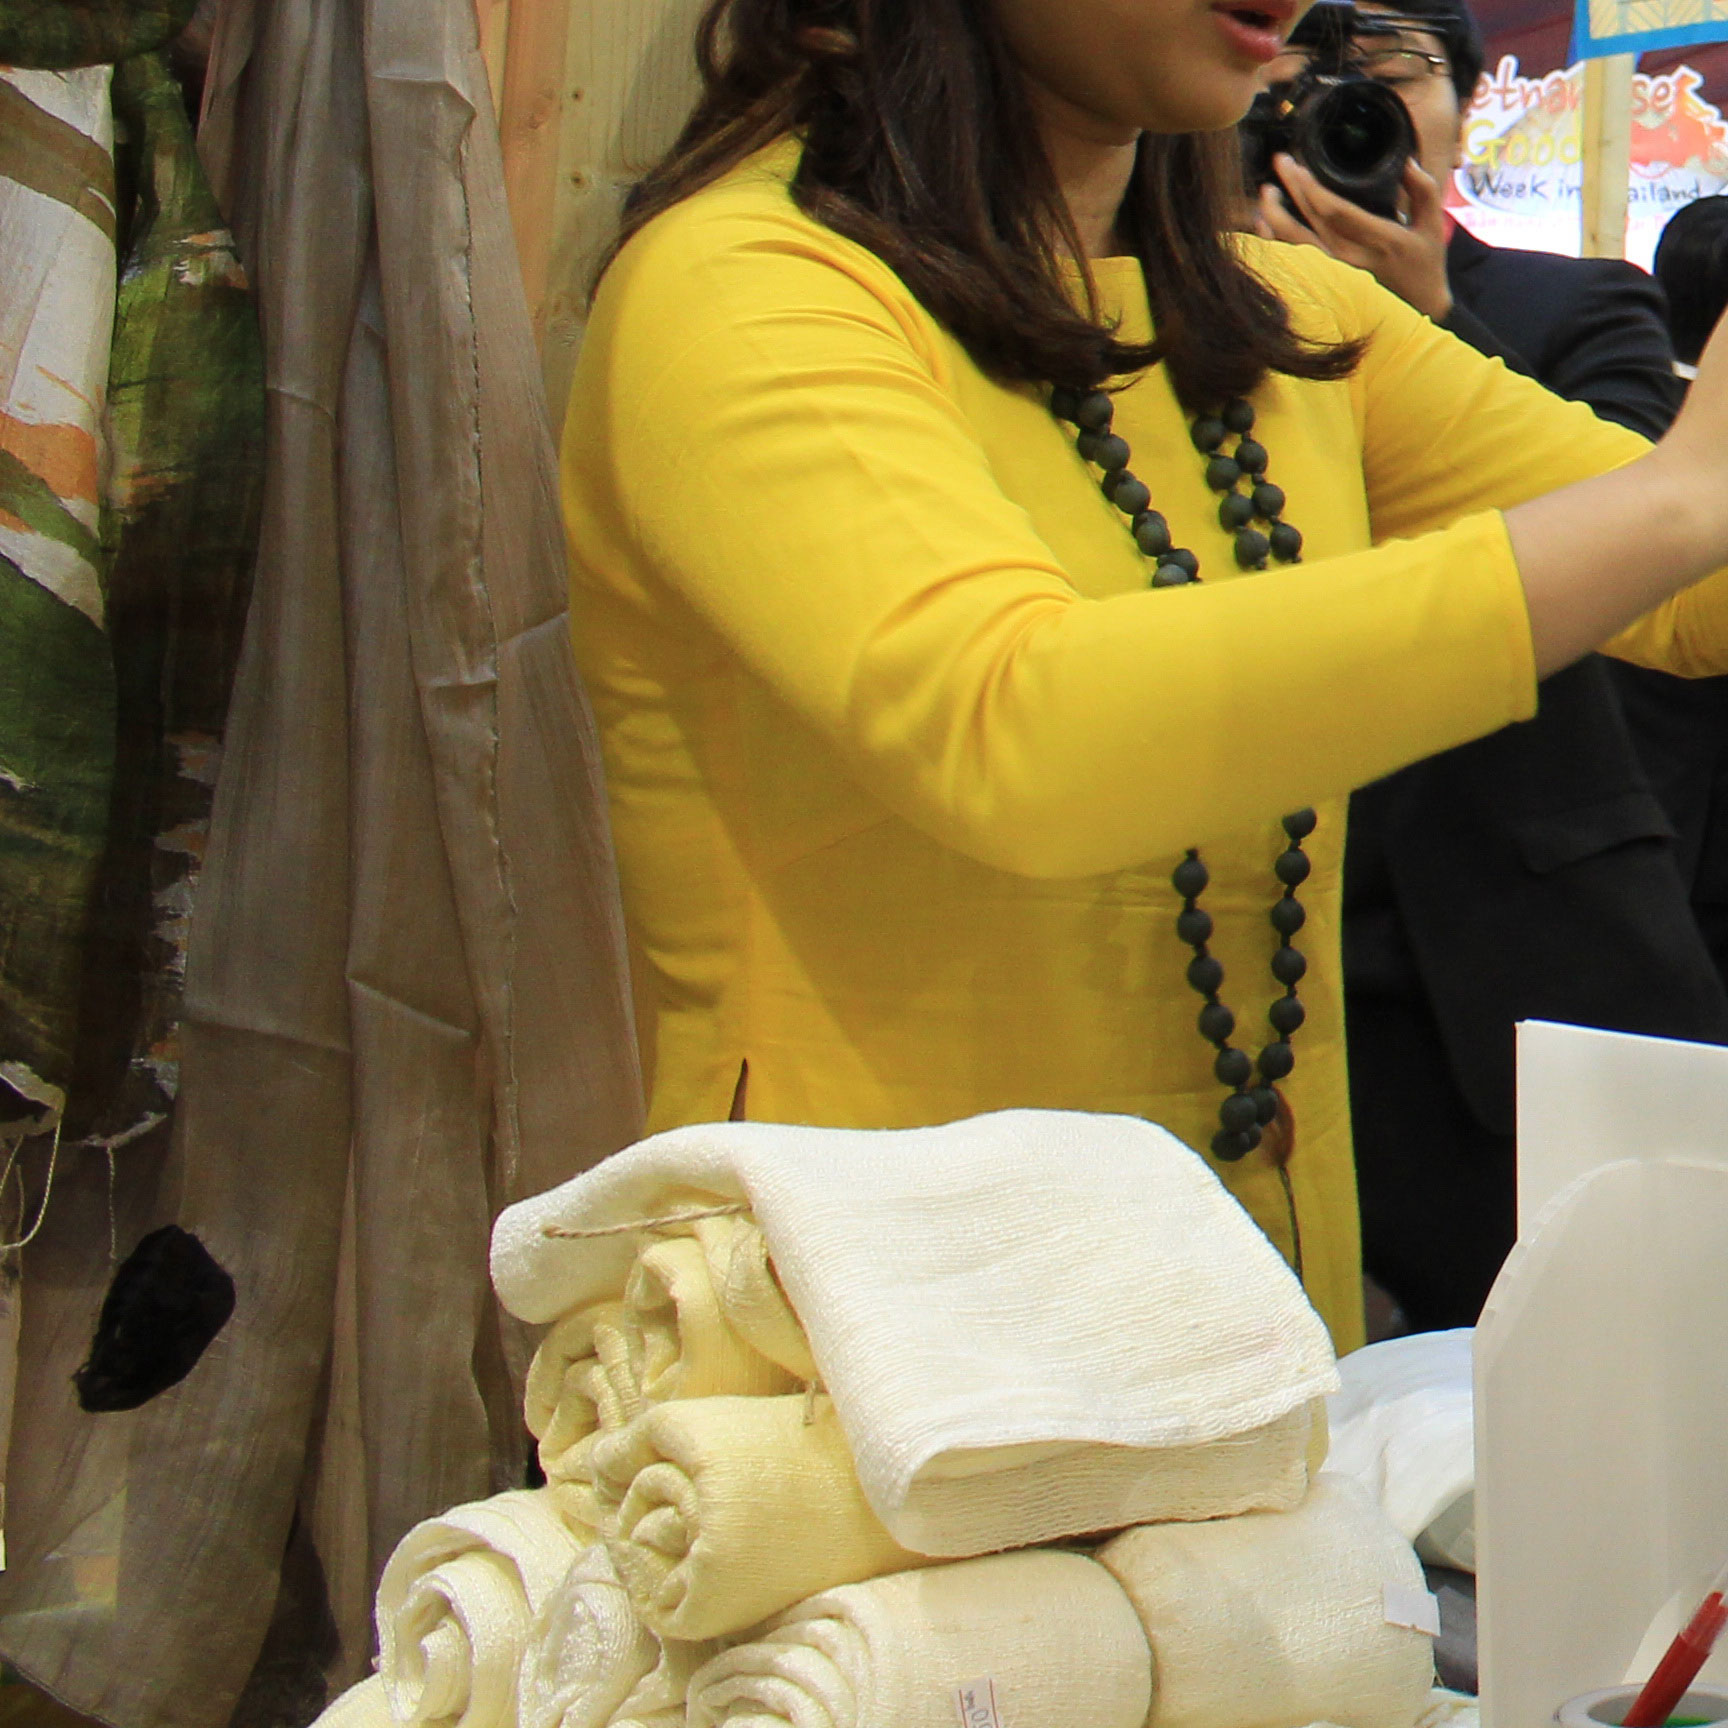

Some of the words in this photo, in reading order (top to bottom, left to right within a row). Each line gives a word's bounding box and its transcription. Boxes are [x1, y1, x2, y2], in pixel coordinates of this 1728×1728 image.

[1464, 106, 1583, 166] Good
[1466, 171, 1549, 200] Week
[1627, 178, 1701, 204] ailand
